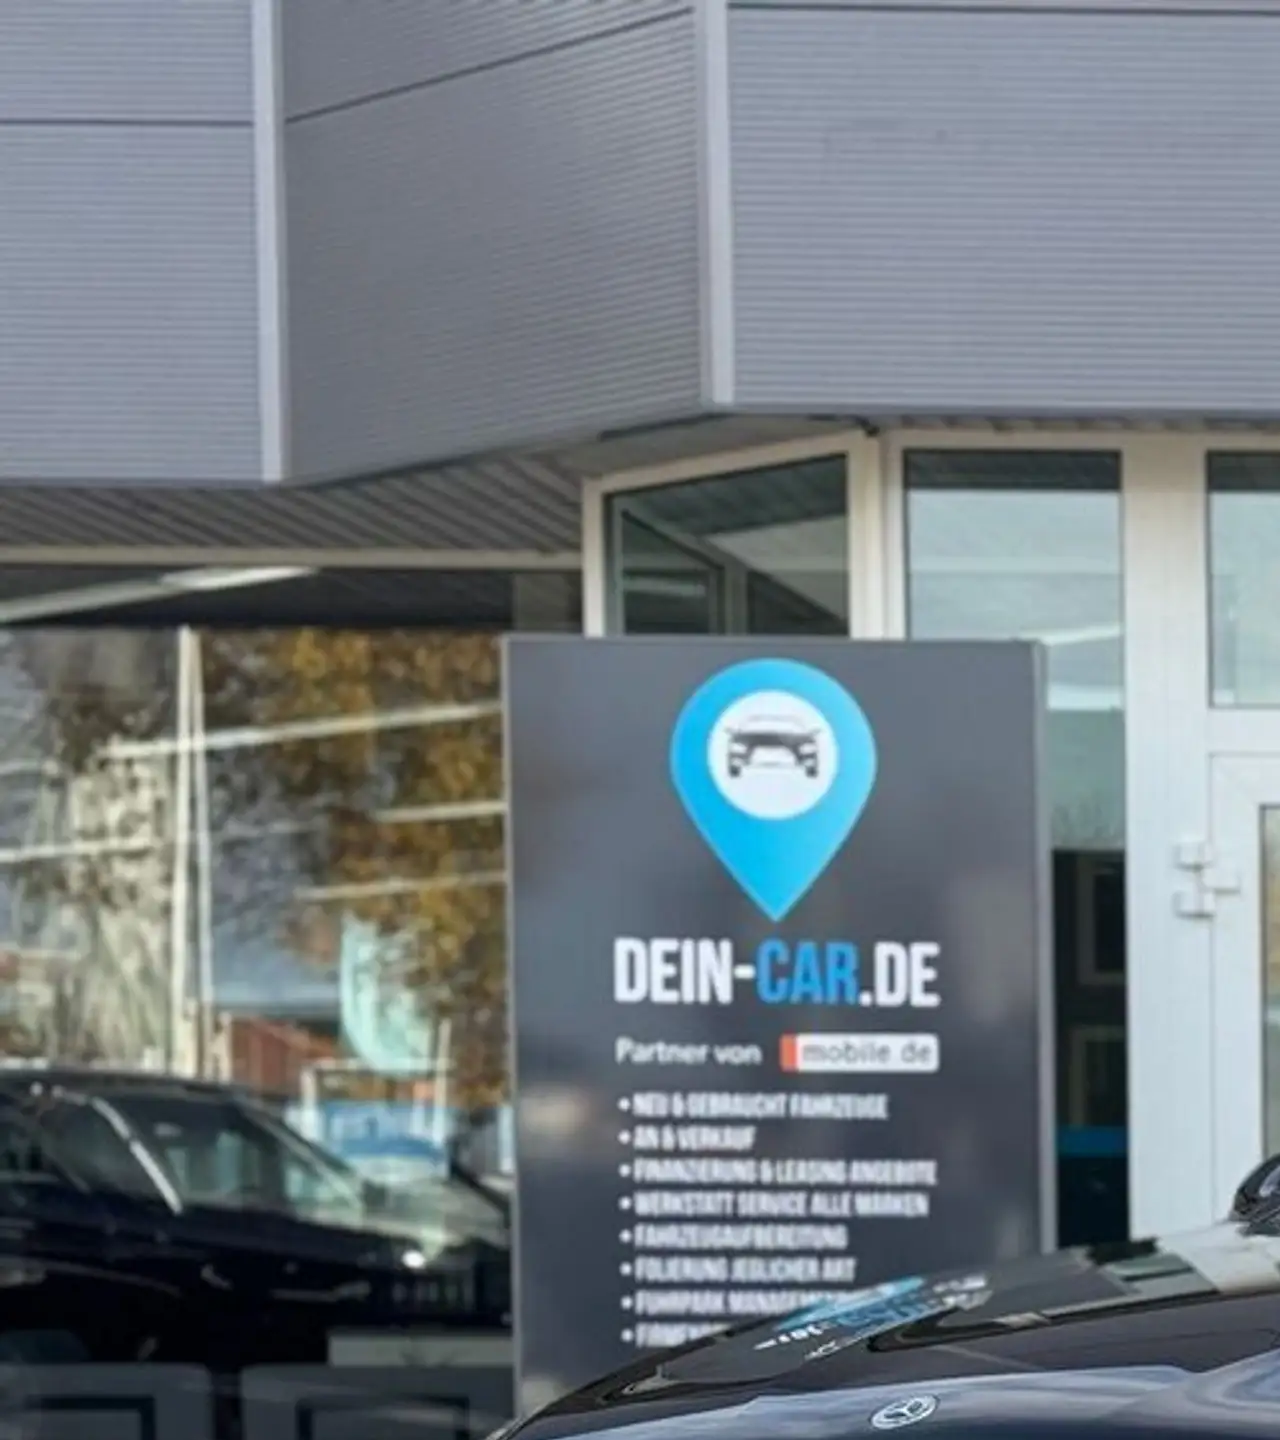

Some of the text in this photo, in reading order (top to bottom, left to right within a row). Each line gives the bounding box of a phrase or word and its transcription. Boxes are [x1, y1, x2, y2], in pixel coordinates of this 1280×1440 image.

[614, 937, 940, 1007] DEIN-CAR.DE
[615, 1036, 709, 1064] Partner
[714, 1043, 763, 1065] von
